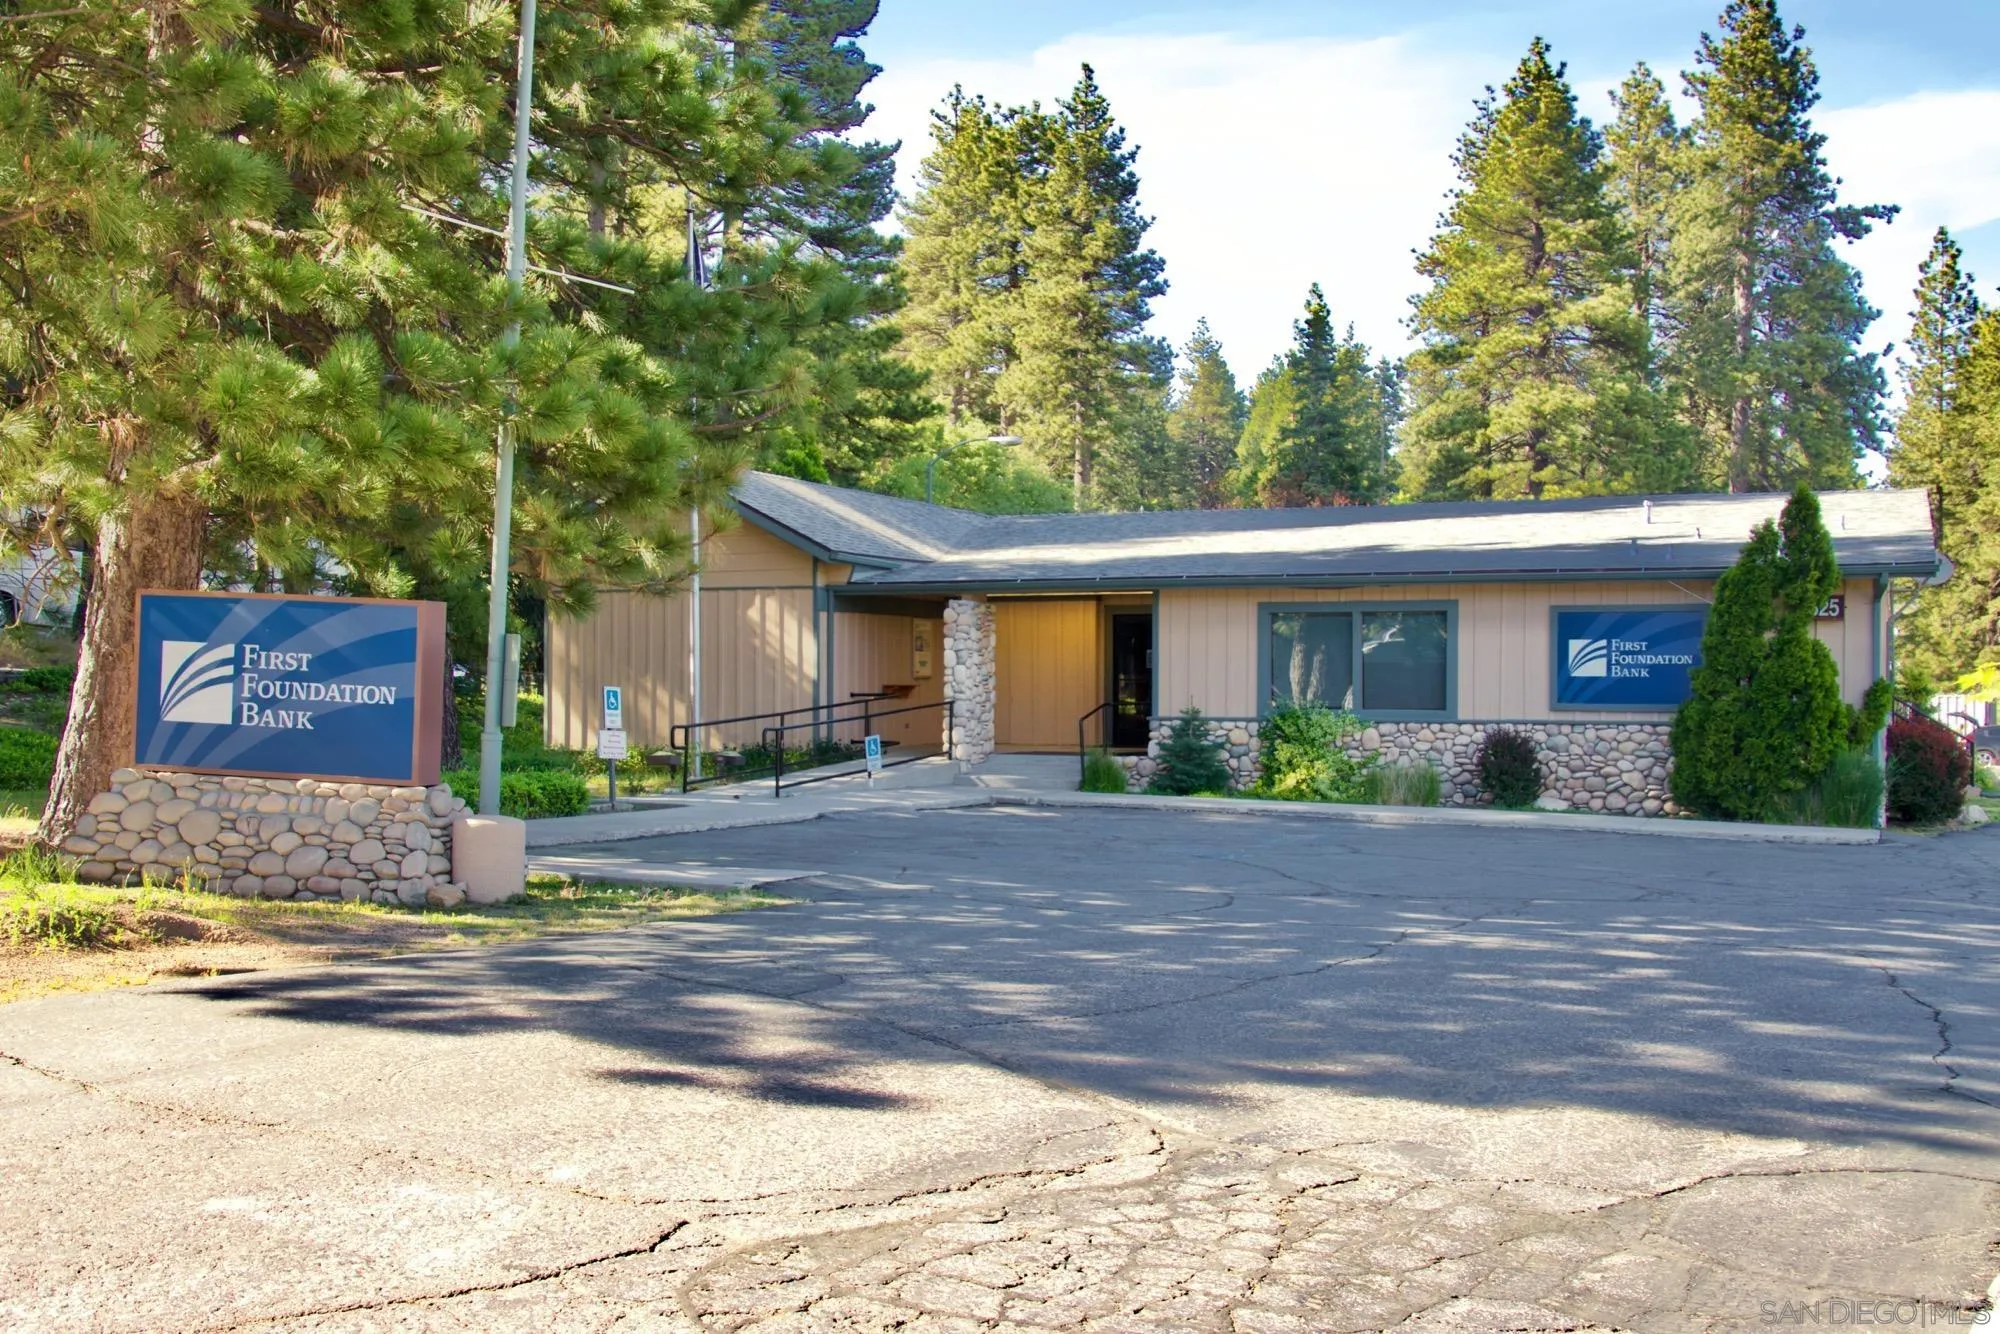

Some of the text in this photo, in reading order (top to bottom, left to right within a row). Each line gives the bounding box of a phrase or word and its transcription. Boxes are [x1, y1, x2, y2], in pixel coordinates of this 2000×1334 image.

[1611, 639, 1648, 651] FIRST
[242, 644, 312, 672] FIRST
[1611, 652, 1693, 665] FOUNDATION
[1611, 665, 1650, 678] BANK
[241, 673, 396, 705] FOUNDATION
[240, 702, 314, 730] BANK
